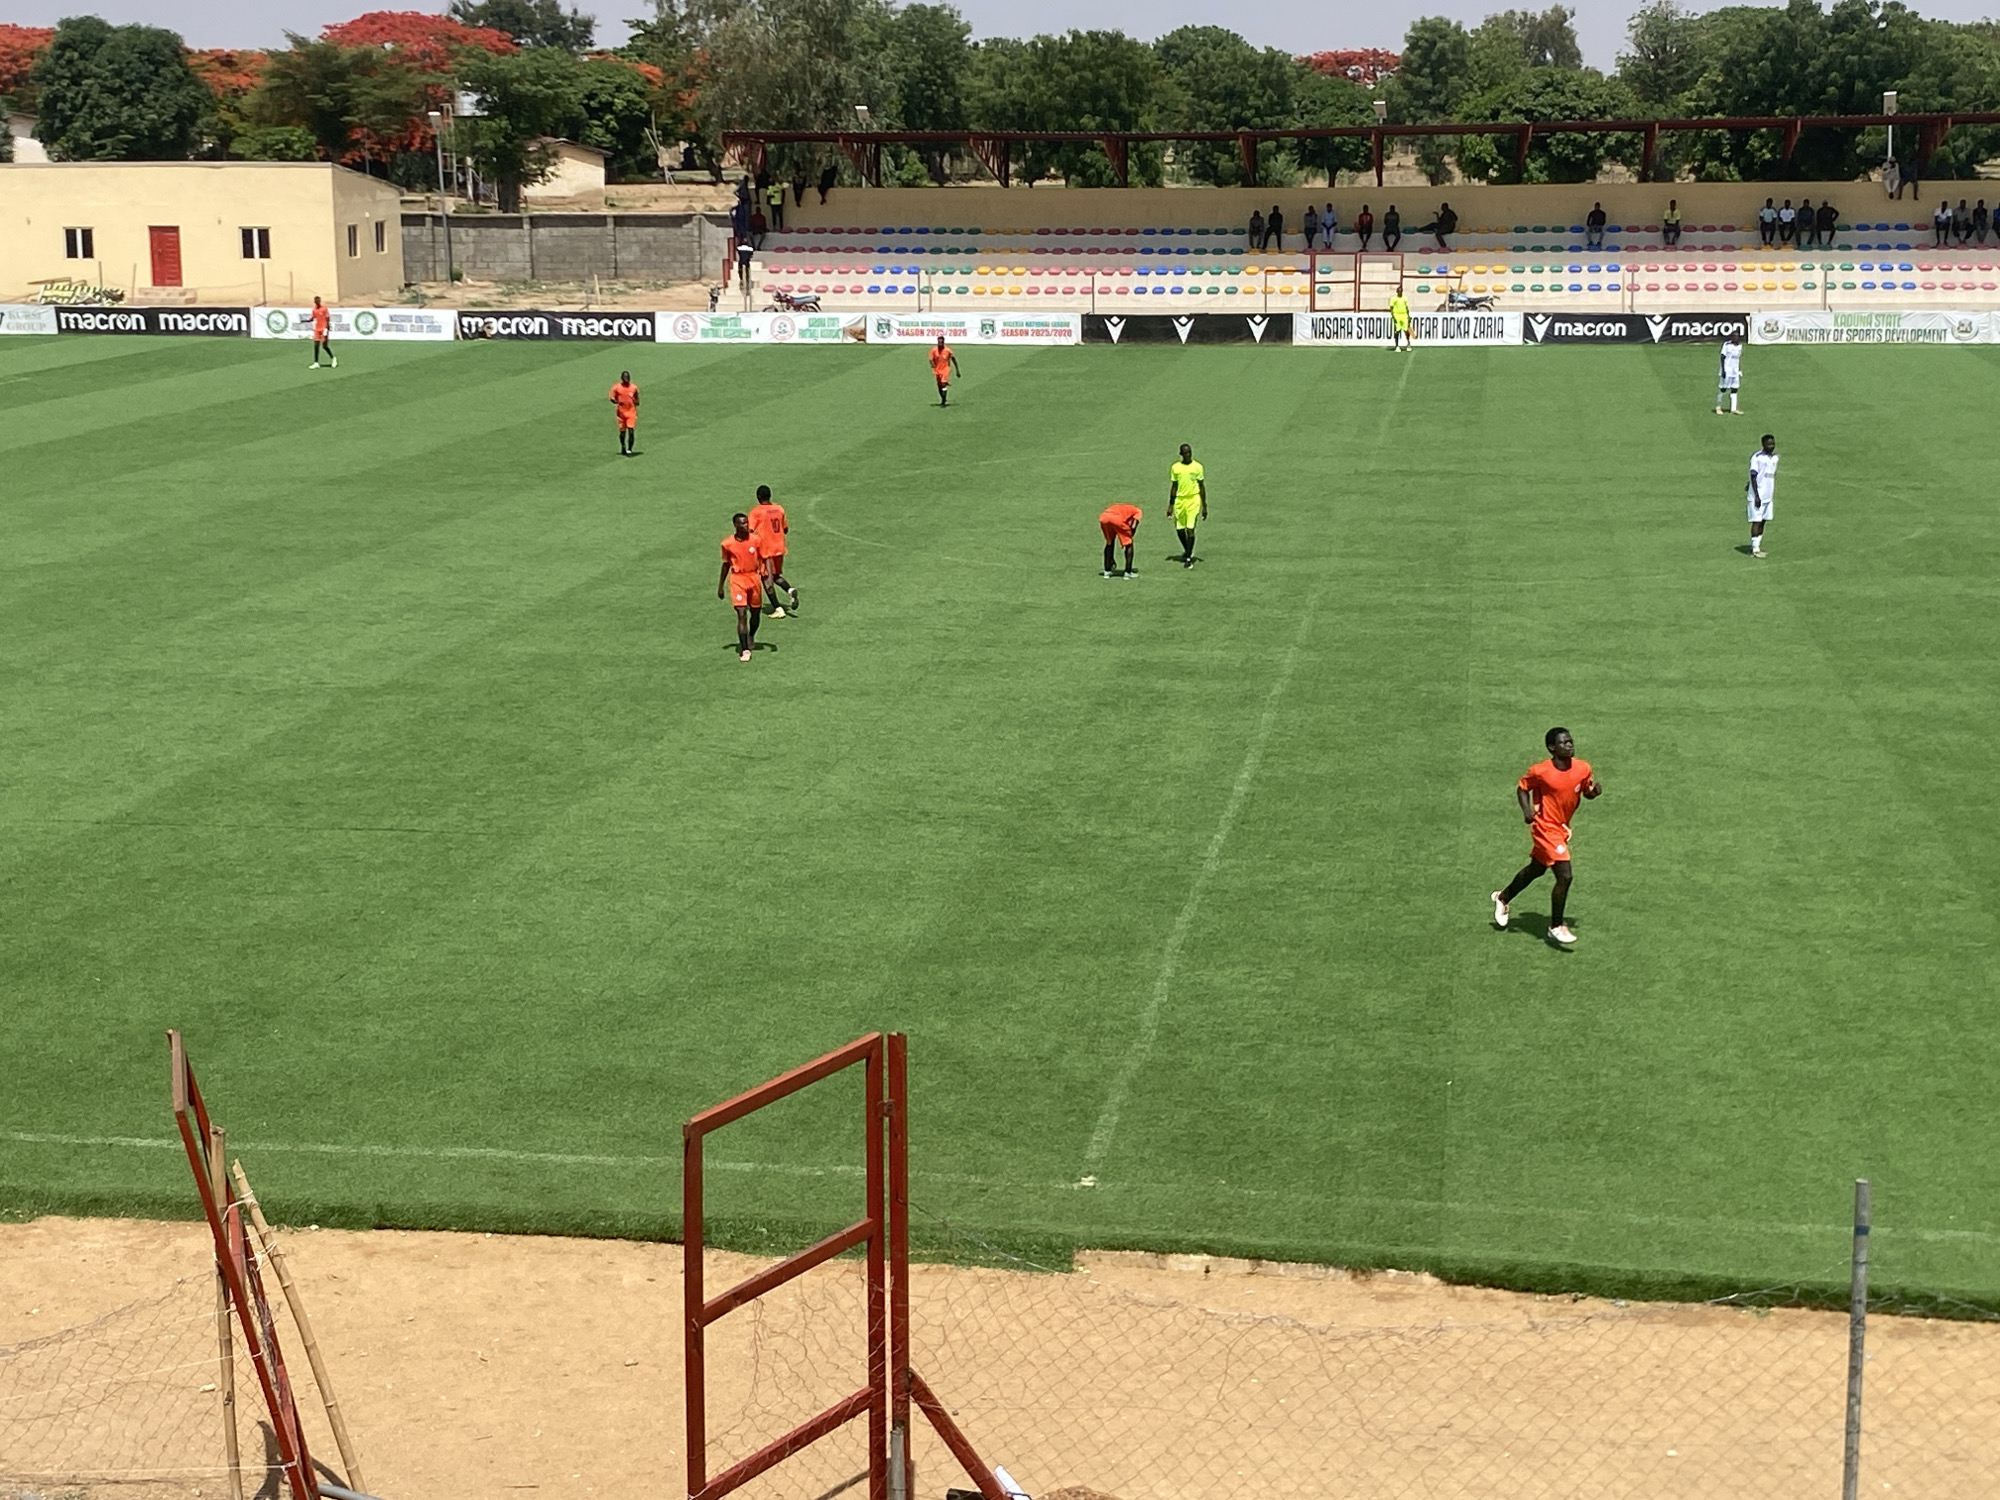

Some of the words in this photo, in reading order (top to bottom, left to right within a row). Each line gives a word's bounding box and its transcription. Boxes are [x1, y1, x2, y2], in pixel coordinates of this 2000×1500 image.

[6, 322, 46, 331] GROUP
[60, 312, 147, 331] macron
[159, 313, 248, 332] macron
[462, 316, 549, 335] macron
[562, 318, 651, 336] macron
[1833, 313, 1872, 328] KADUNA
[1874, 313, 1901, 328] STATE
[1001, 329, 1029, 337] SEASON
[1311, 317, 1353, 339] NASARA
[1356, 317, 1402, 340] STADIU
[1442, 317, 1470, 339] DOKA
[1473, 317, 1504, 339] ZARIA
[1554, 322, 1626, 337] macron
[1671, 322, 1744, 337] macron
[1786, 328, 1830, 341] MINISTRY
[1832, 328, 1843, 341] OF
[1846, 328, 1882, 341] SPORTS
[1884, 328, 1947, 342] DEVELOPMENT
[770, 517, 781, 533] 10
